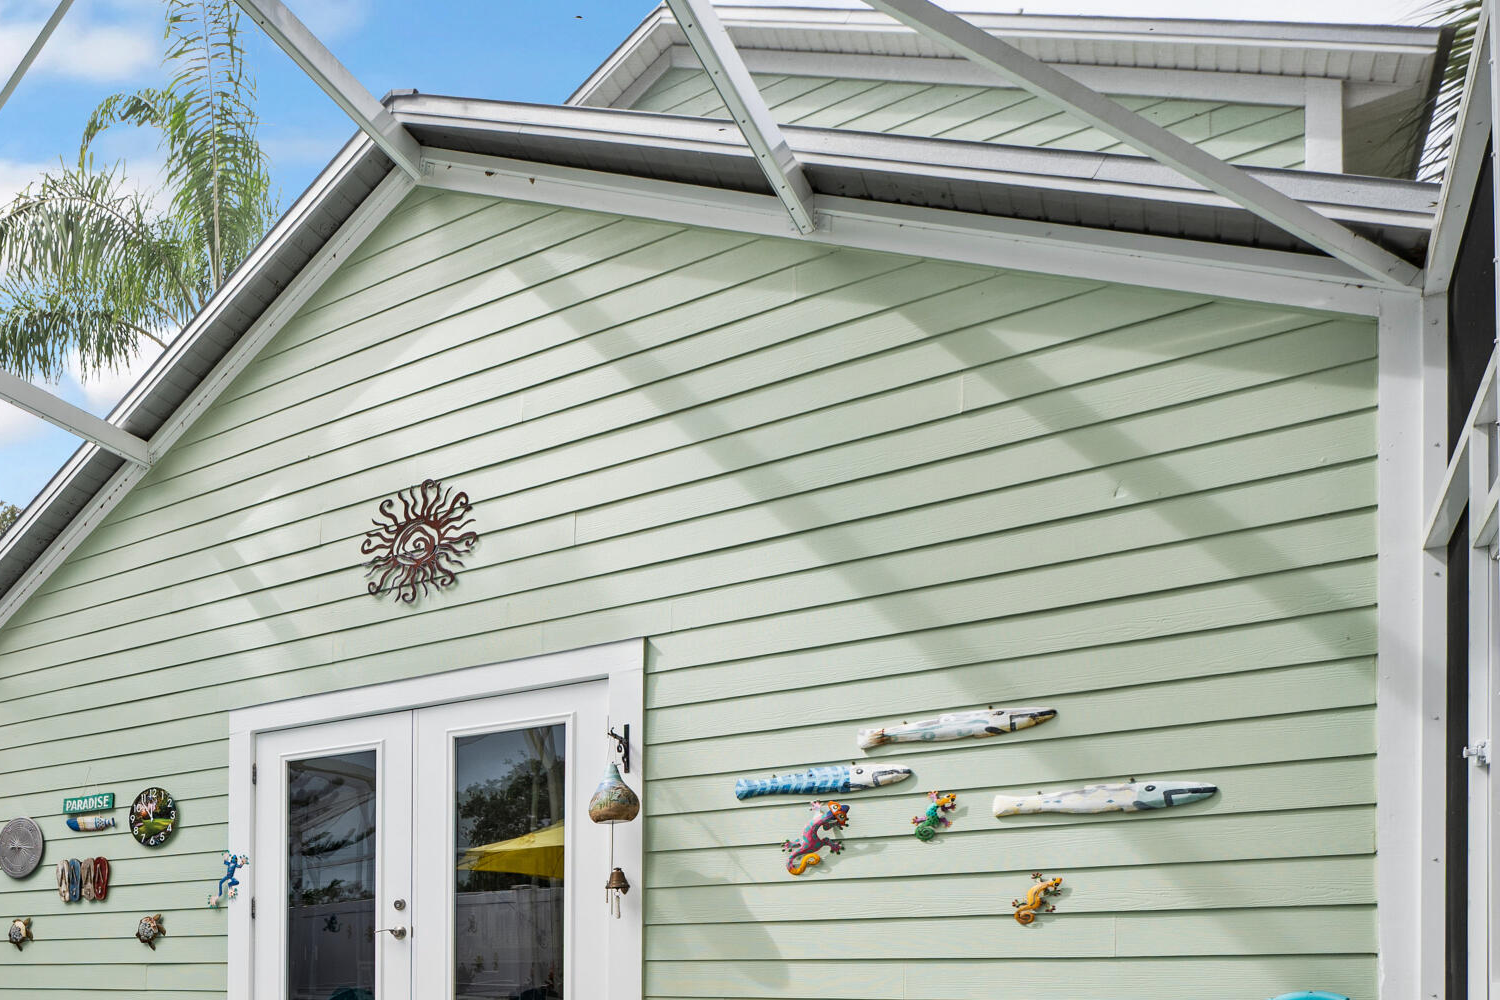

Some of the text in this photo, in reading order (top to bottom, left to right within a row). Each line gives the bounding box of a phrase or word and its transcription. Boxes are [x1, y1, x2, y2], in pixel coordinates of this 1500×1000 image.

[149, 788, 157, 798] 12
[65, 795, 110, 811] PARADISE
[167, 798, 173, 808] 2
[130, 814, 136, 824] 9
[170, 810, 176, 820] 3
[133, 826, 139, 835] 8
[166, 823, 172, 832] 4
[140, 833, 146, 843] 7
[149, 836, 155, 845] 6
[159, 831, 165, 841] 5
